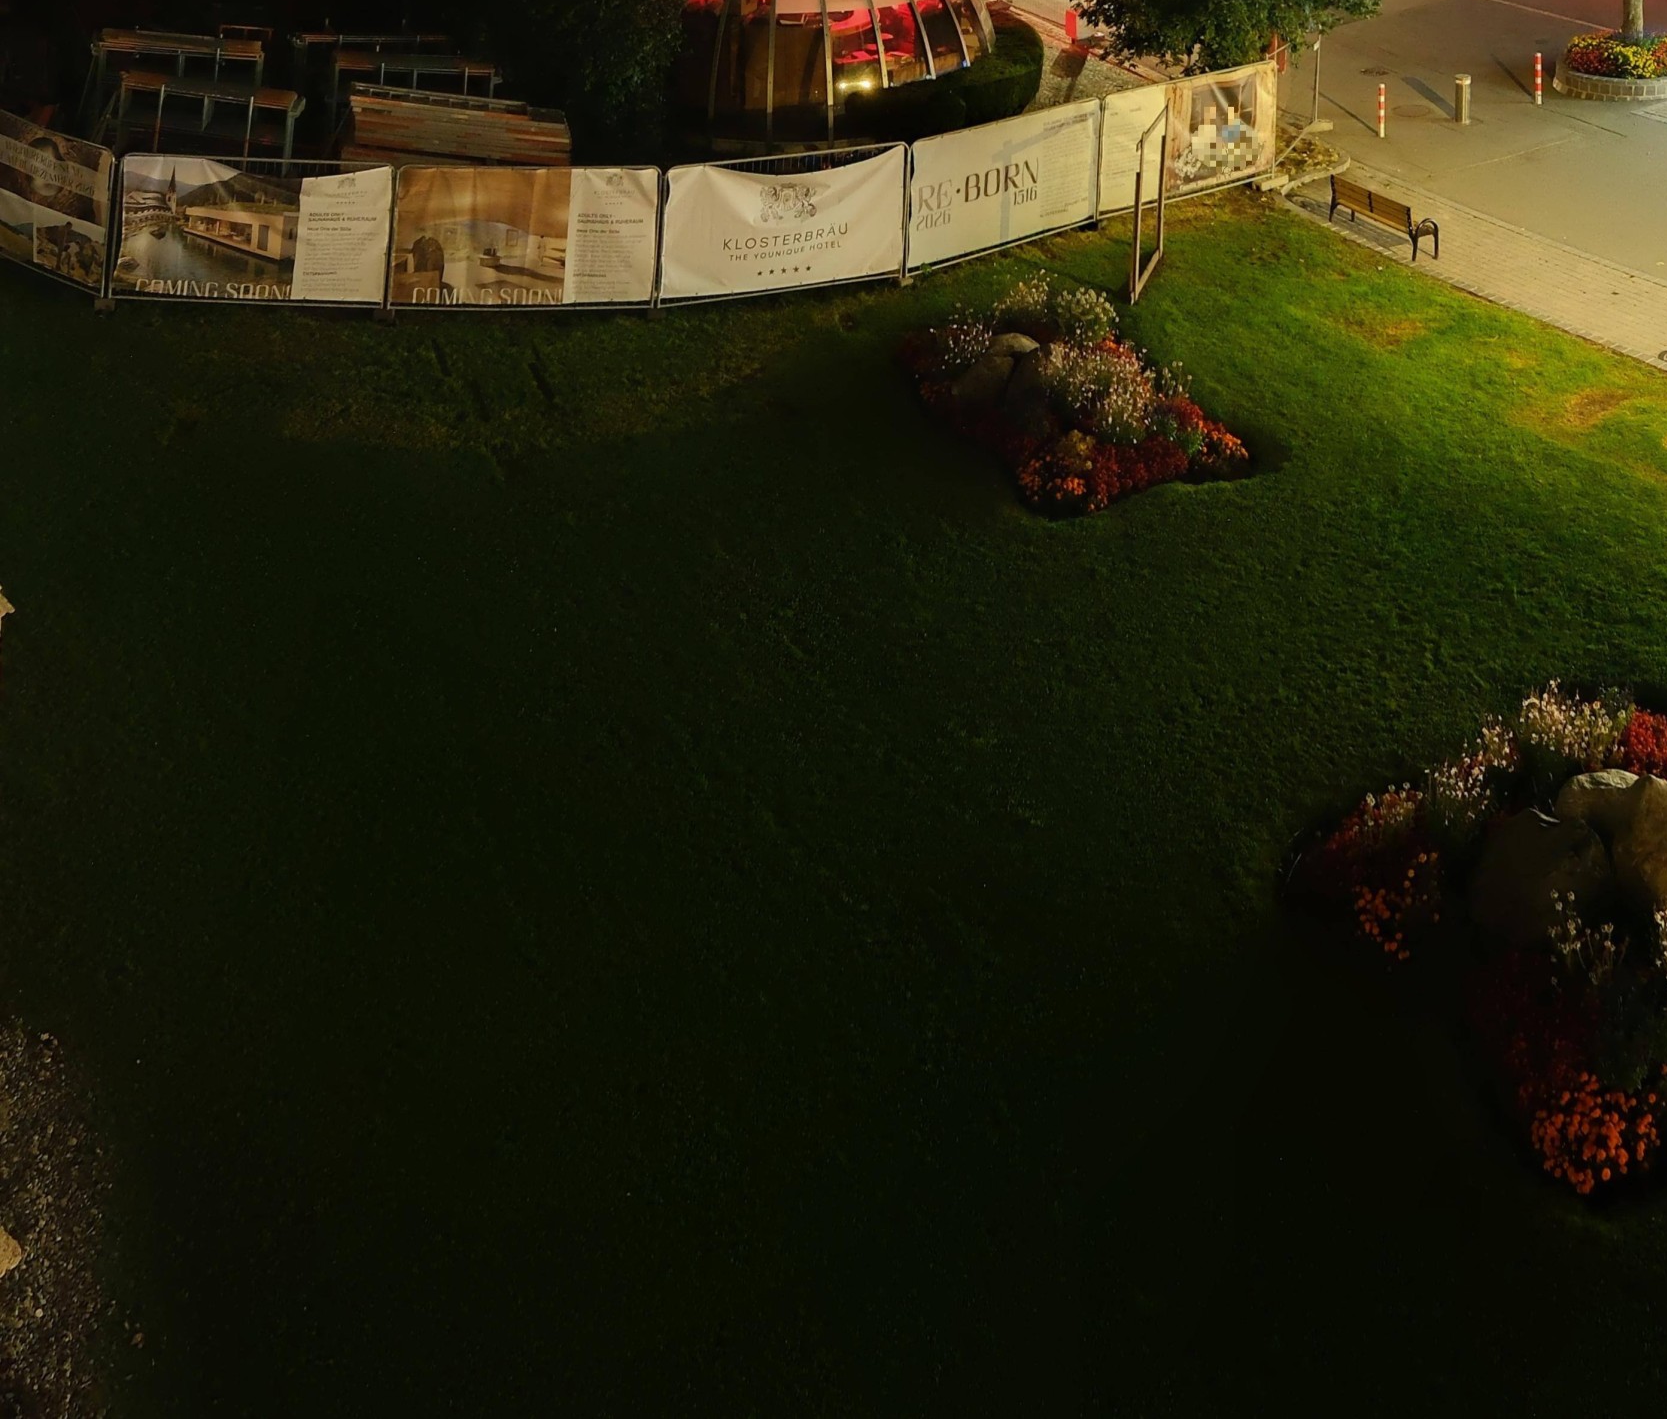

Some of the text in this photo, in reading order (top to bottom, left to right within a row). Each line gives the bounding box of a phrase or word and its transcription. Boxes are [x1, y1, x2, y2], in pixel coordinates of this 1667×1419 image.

[1013, 184, 1038, 207] 1516
[915, 209, 951, 232] 2026
[722, 222, 849, 252] KLOSTERBRÄU
[729, 240, 842, 262] THE YOUNIQUE HOTEL
[135, 278, 219, 299] COMING
[225, 282, 294, 300] SOON!
[412, 287, 494, 305] COMING
[499, 287, 565, 305] SOON!
